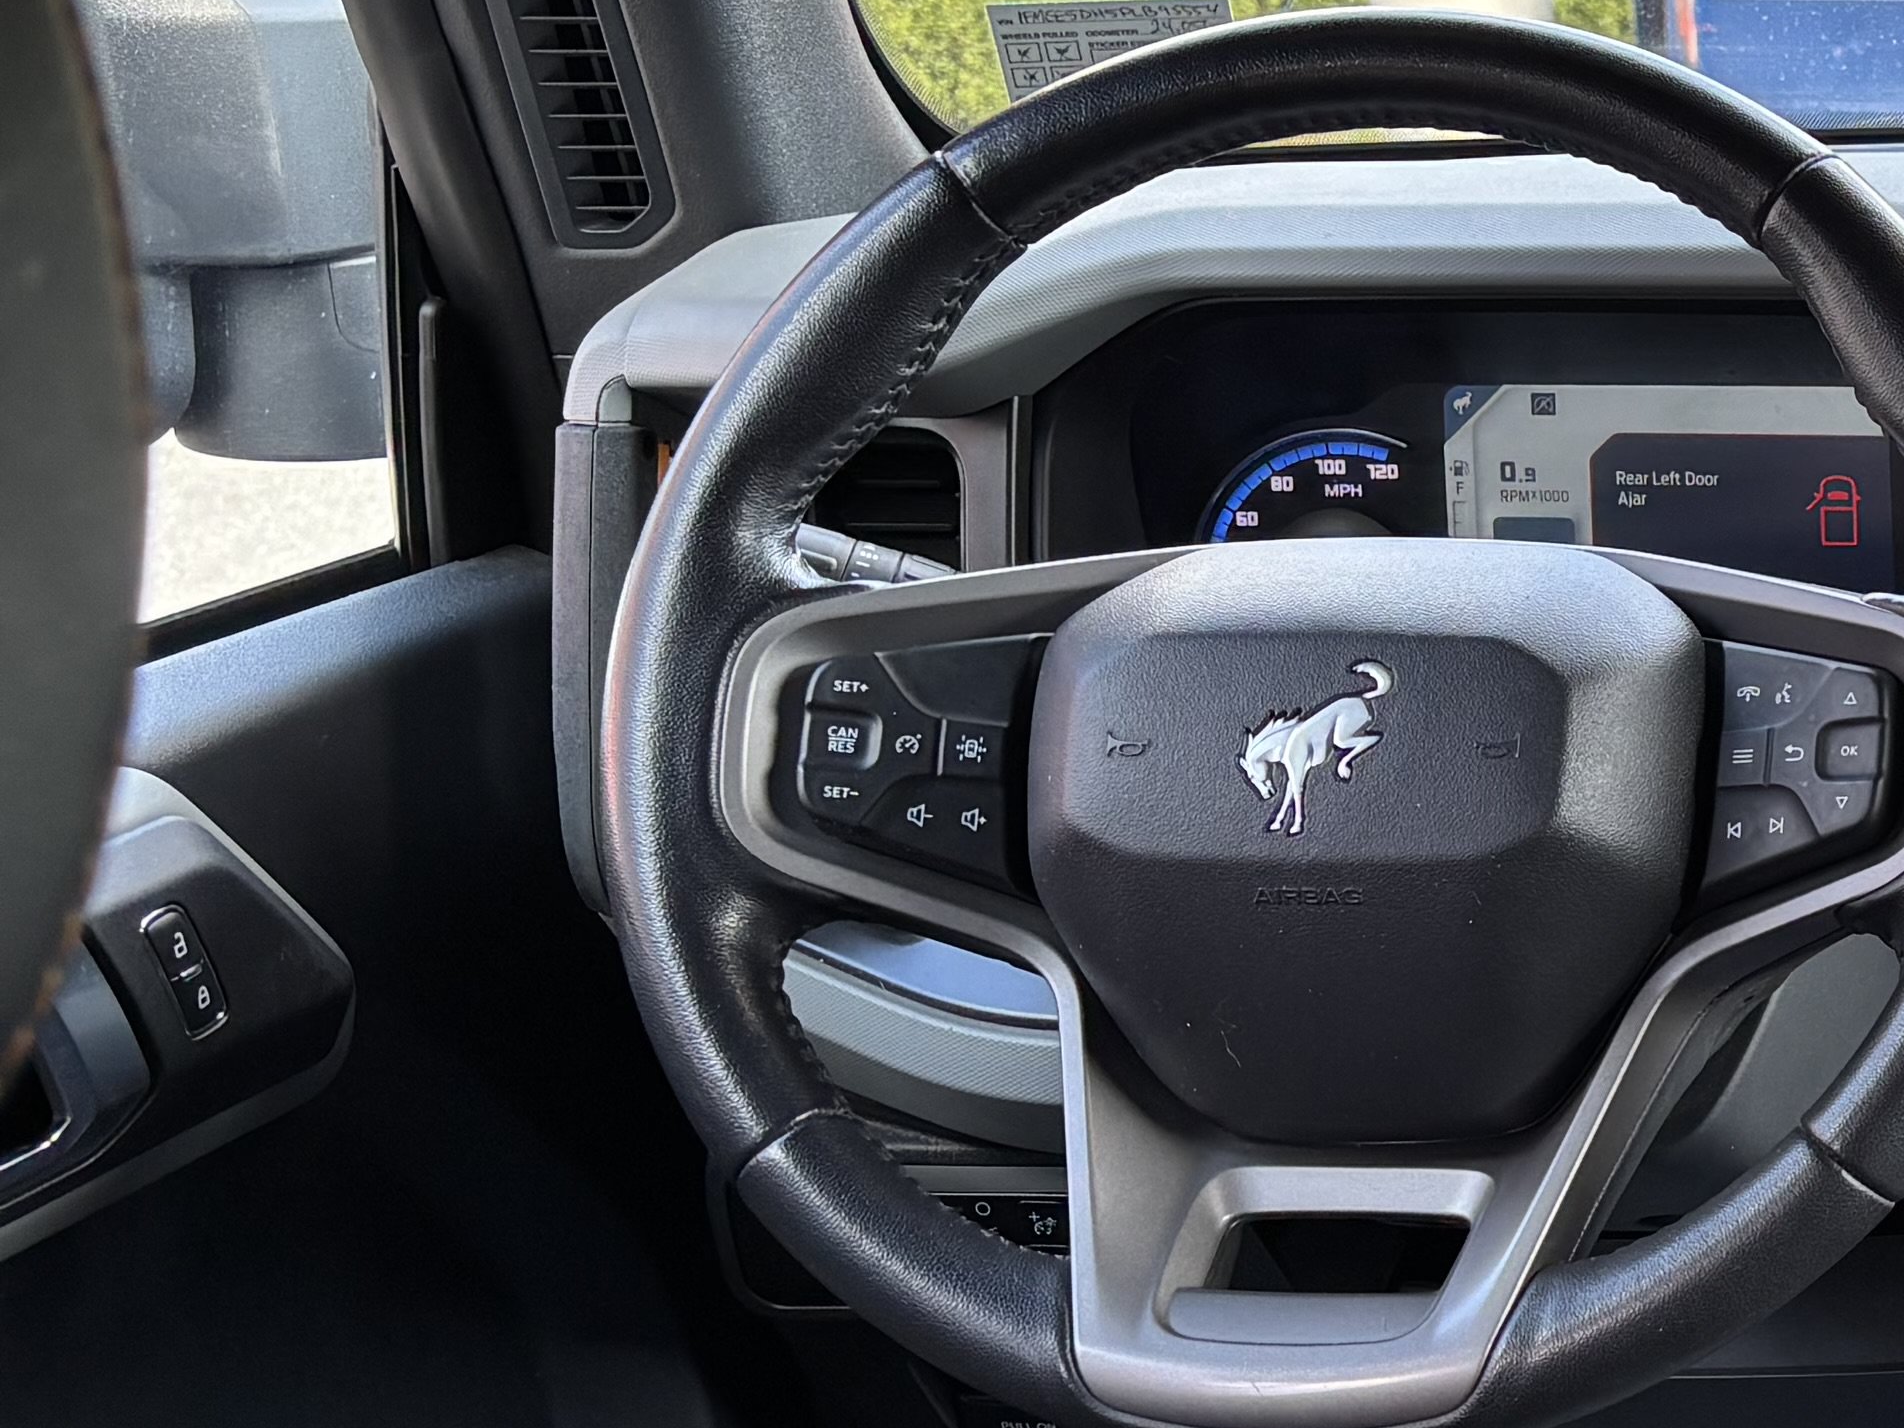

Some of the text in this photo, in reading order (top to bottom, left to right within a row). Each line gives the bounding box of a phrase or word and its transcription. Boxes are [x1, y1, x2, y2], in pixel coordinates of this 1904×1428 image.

[1042, 31, 1079, 39] PULLED
[1085, 29, 1139, 37] ODOMETER
[1315, 459, 1347, 476] 100
[1366, 463, 1399, 481] 120
[1500, 461, 1537, 483] 0.9
[1270, 476, 1294, 492] 80
[1615, 471, 1719, 486] Rear Left Door
[1324, 483, 1364, 498] MPH
[1456, 482, 1464, 495] F
[1618, 491, 1647, 507] Ajar
[1235, 511, 1259, 527] 60
[827, 726, 859, 739] CAN
[827, 740, 855, 754] RES
[1840, 745, 1859, 756] OK
[1253, 886, 1364, 906] AIRBAG
